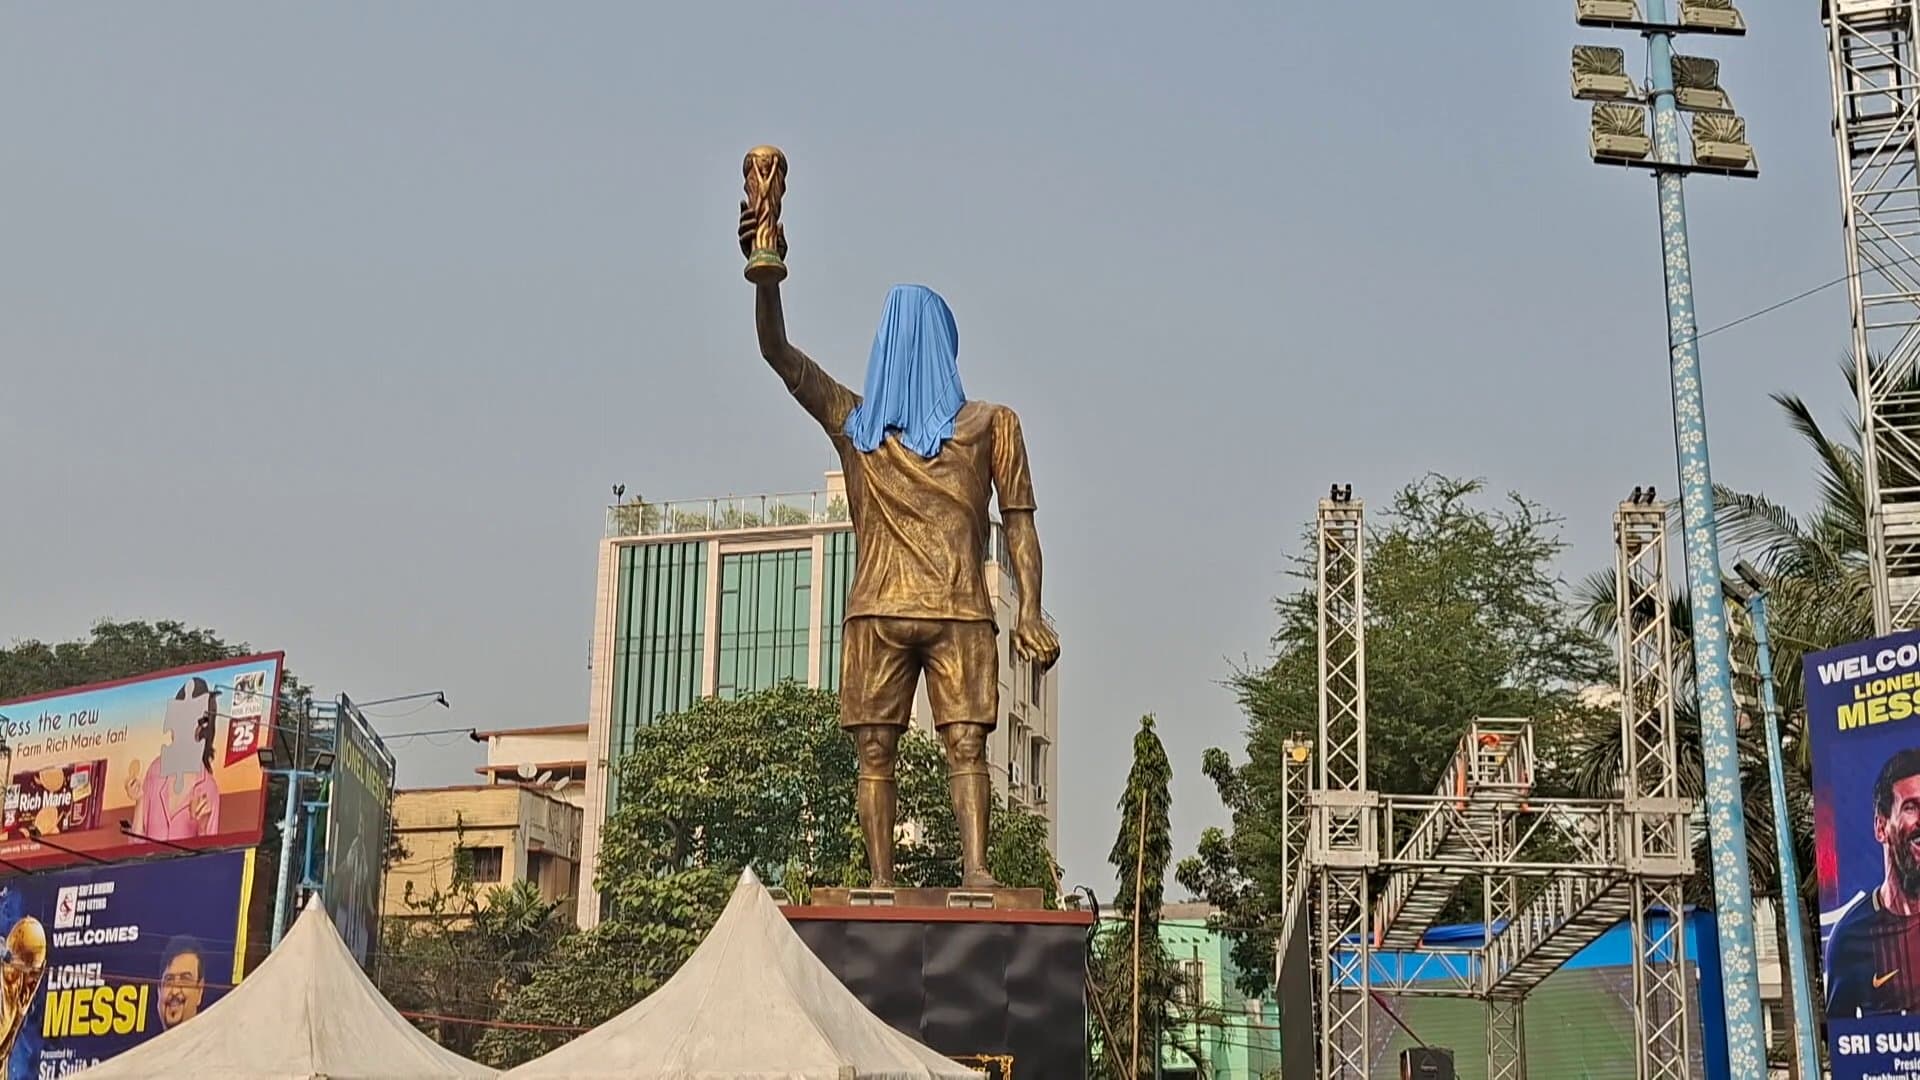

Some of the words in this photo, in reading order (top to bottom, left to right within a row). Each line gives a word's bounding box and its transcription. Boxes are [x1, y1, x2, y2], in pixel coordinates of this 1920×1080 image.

[1817, 642, 1920, 685] WELCO
[38, 709, 61, 734] the
[68, 708, 100, 729] new
[17, 742, 42, 757] Farm
[46, 737, 67, 753] Rich
[71, 733, 102, 750] Marie
[106, 725, 128, 744] fan!
[233, 722, 255, 748] 25
[20, 791, 42, 812] Rich
[42, 788, 72, 808] Marie
[53, 925, 139, 948] WELCOMES
[47, 962, 105, 990] LIONEL
[43, 984, 149, 1038] MESSI
[1838, 1034, 1870, 1055] SRI
